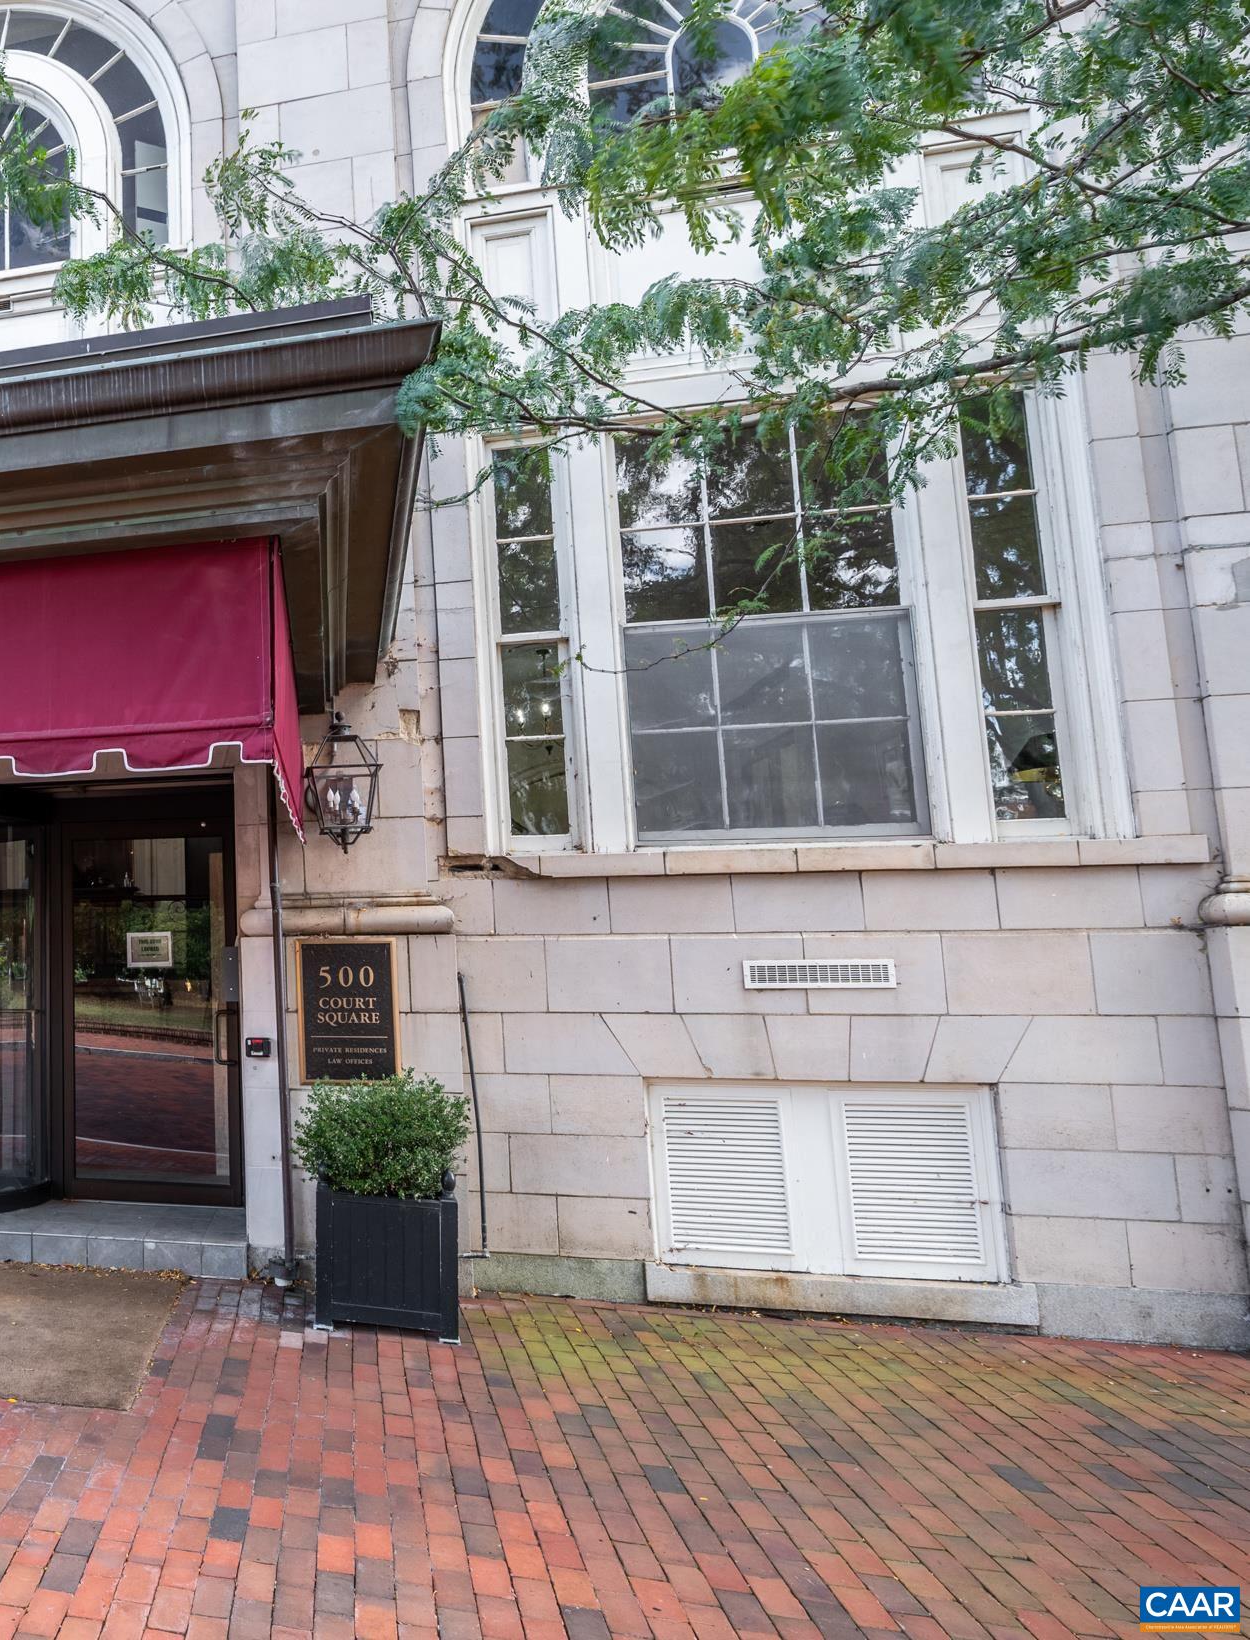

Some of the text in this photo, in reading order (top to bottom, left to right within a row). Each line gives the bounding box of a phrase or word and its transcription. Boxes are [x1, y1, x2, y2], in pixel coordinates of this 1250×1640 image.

[319, 965, 374, 988] 500
[319, 997, 376, 1009] COURT
[317, 1012, 380, 1026] SQUARE
